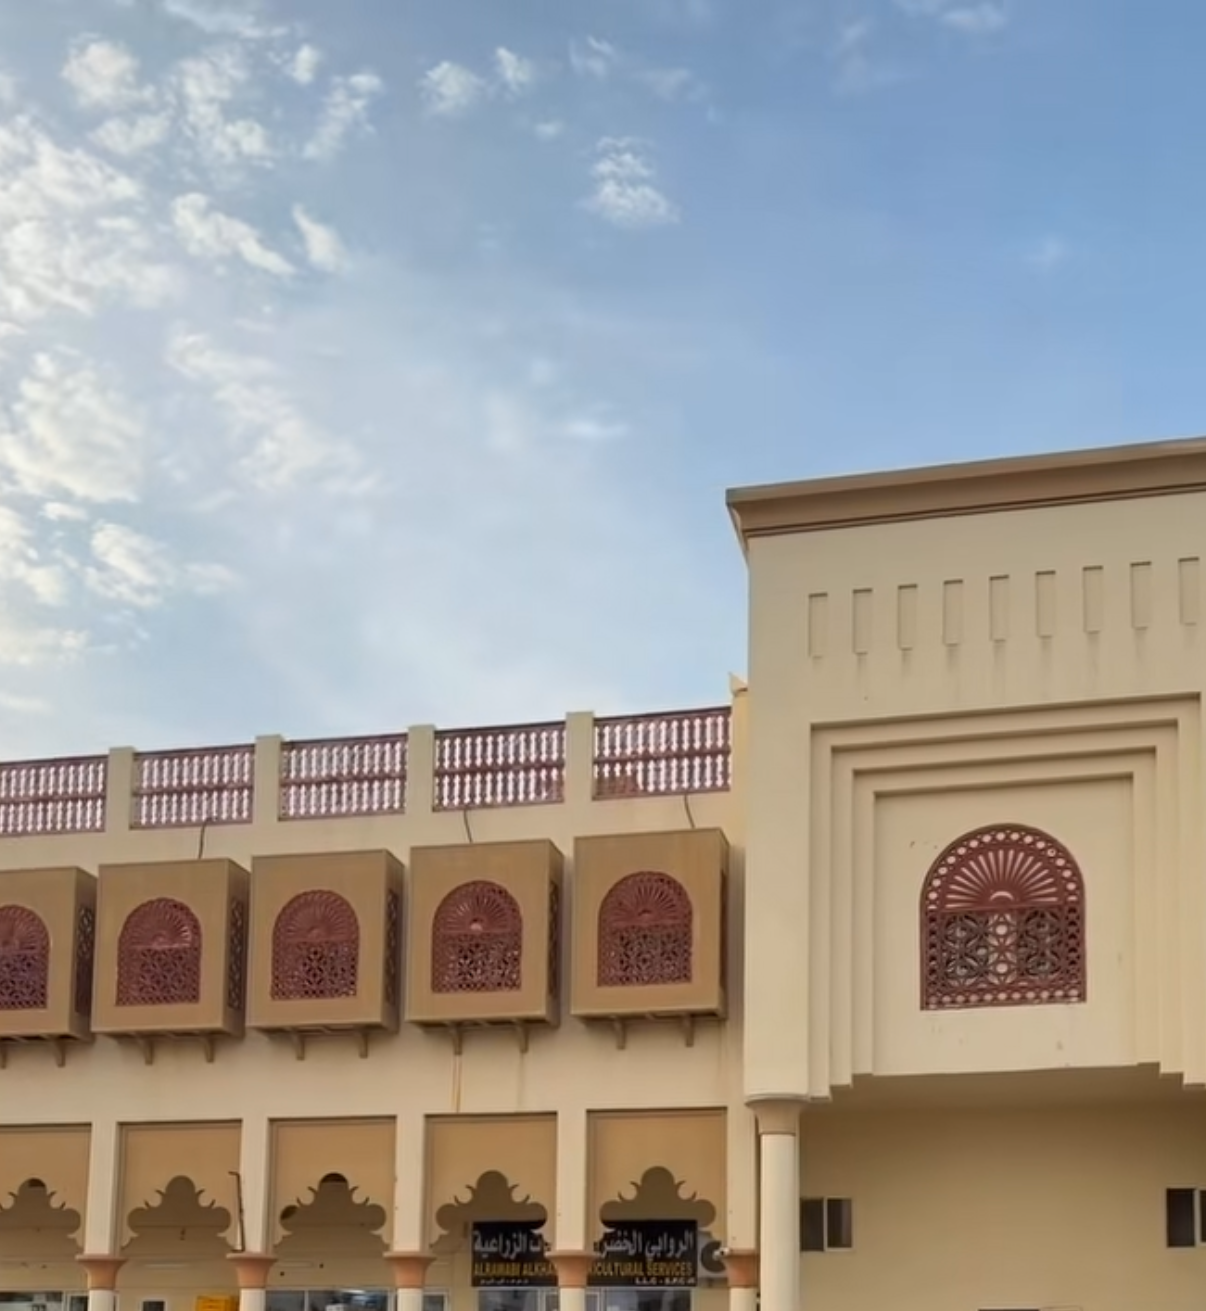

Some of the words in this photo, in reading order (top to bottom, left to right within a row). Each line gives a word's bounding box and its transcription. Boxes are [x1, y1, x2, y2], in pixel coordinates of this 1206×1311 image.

[473, 1230, 528, 1260] الزراعية
[600, 1229, 643, 1259] الخضر
[645, 1229, 694, 1261] الروابي
[646, 1261, 693, 1277] SERVICES
